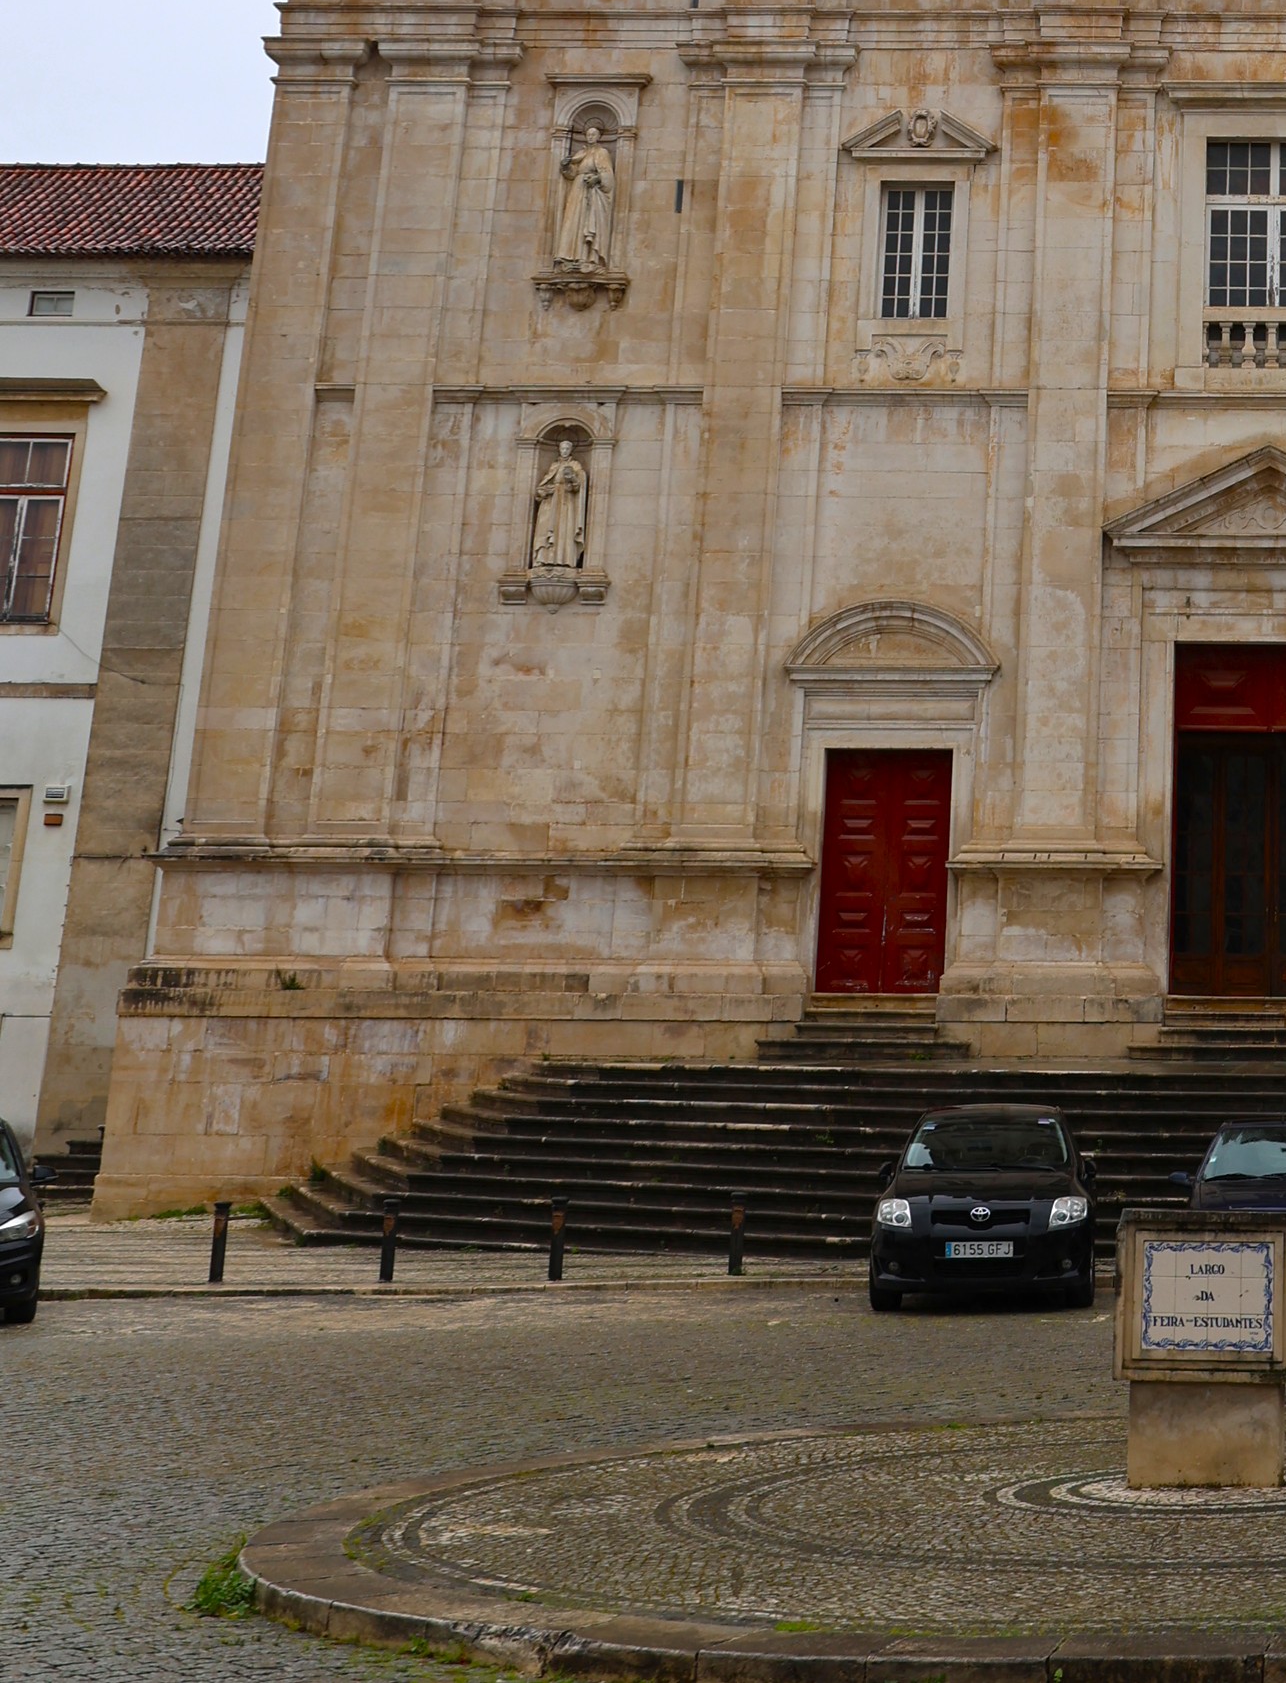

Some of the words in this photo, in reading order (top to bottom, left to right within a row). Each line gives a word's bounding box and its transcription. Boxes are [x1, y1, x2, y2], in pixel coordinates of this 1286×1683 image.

[953, 1243, 984, 1256] 6155
[987, 1242, 1011, 1256] GFJ
[1190, 1263, 1226, 1275] LARGO
[1200, 1290, 1215, 1302] DA
[1153, 1315, 1185, 1327] FEIRA
[1193, 1316, 1263, 1330] ESTUDANTES
